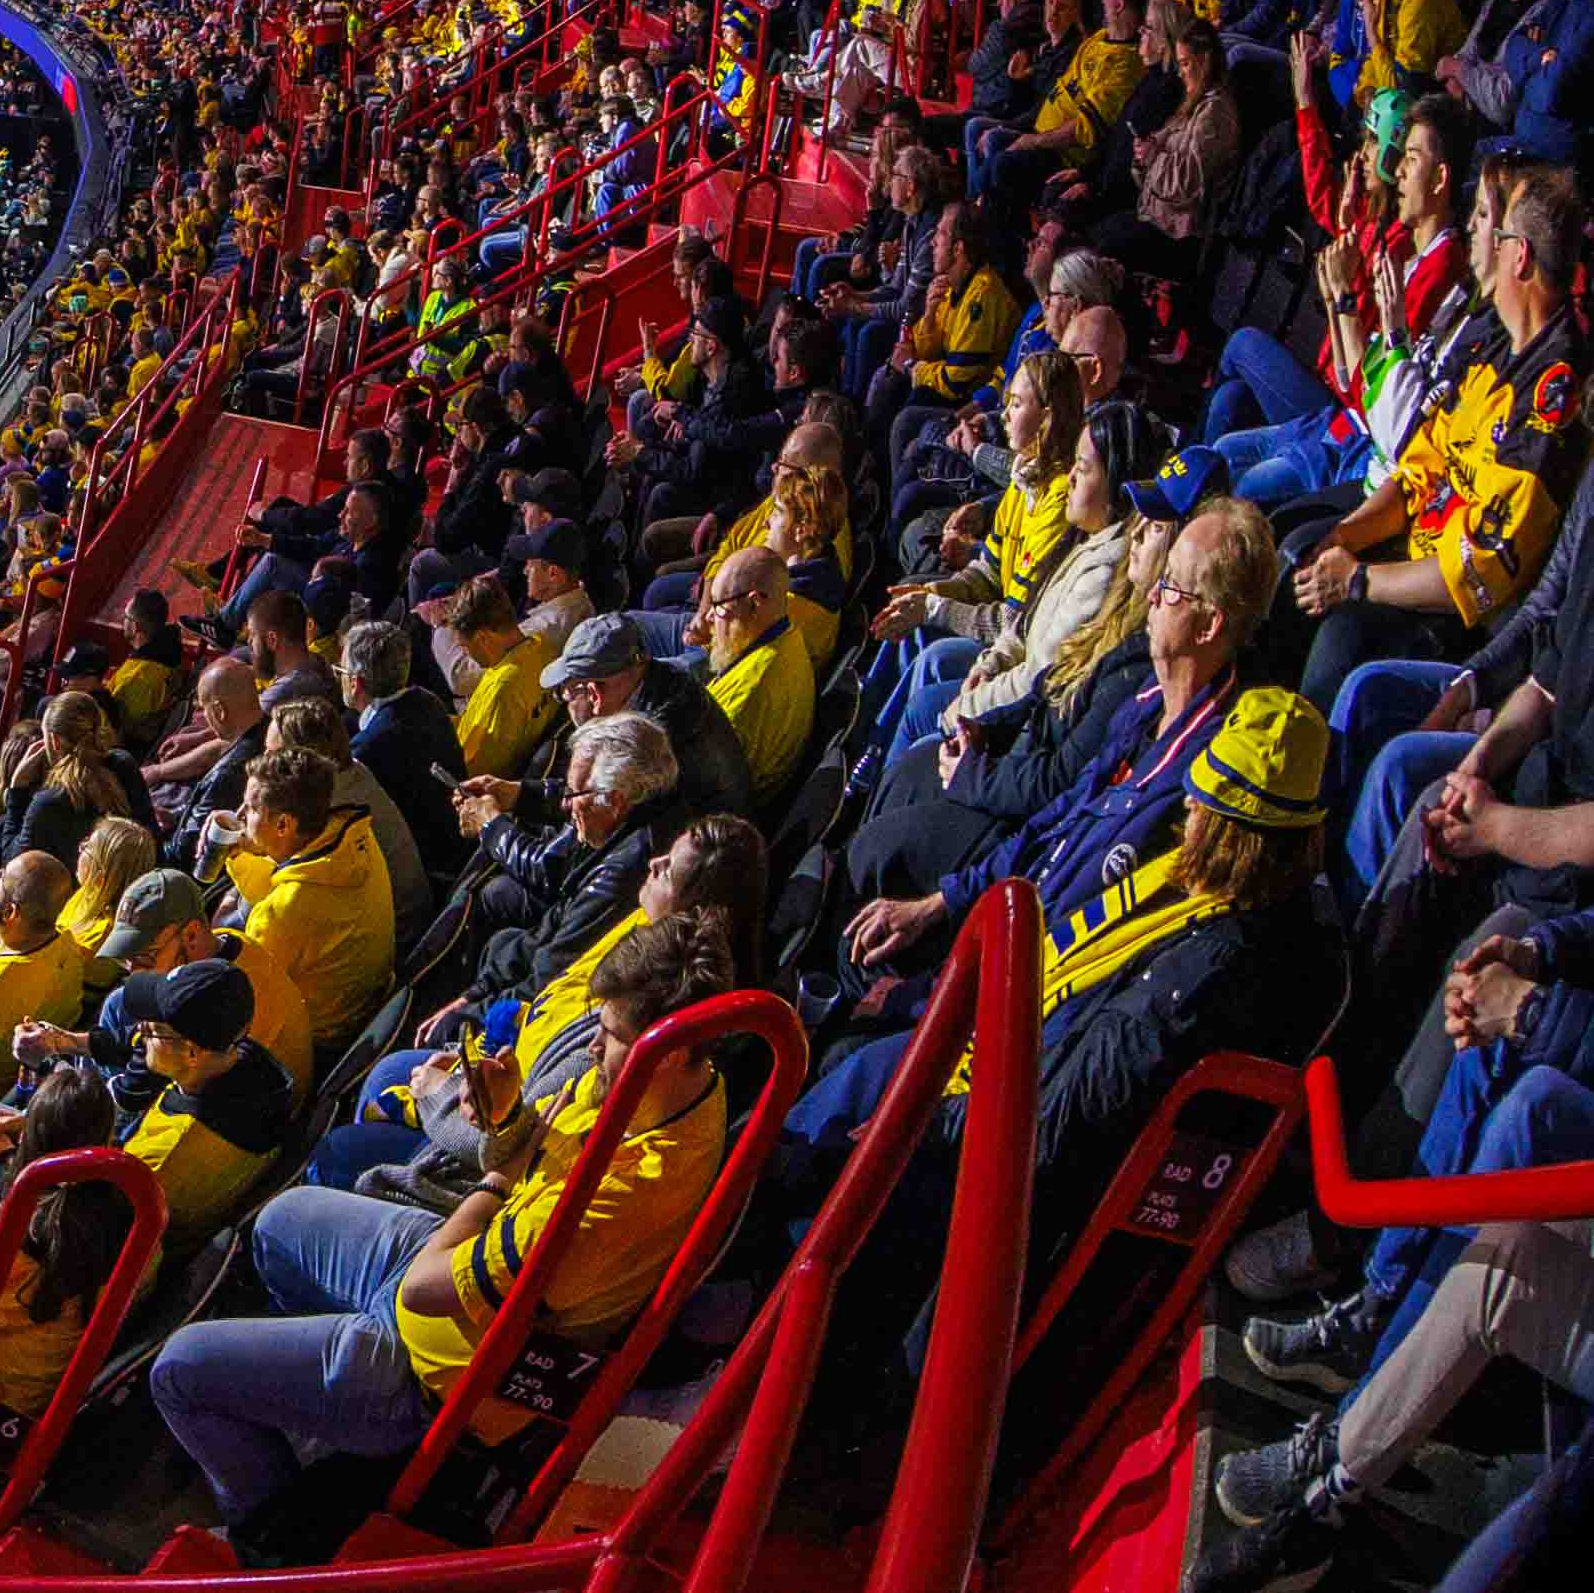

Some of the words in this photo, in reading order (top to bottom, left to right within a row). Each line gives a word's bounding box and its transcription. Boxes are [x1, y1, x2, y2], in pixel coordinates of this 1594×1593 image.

[1202, 1153, 1232, 1189] 8
[566, 1352, 598, 1380] 7
[0, 1416, 20, 1438] 6
